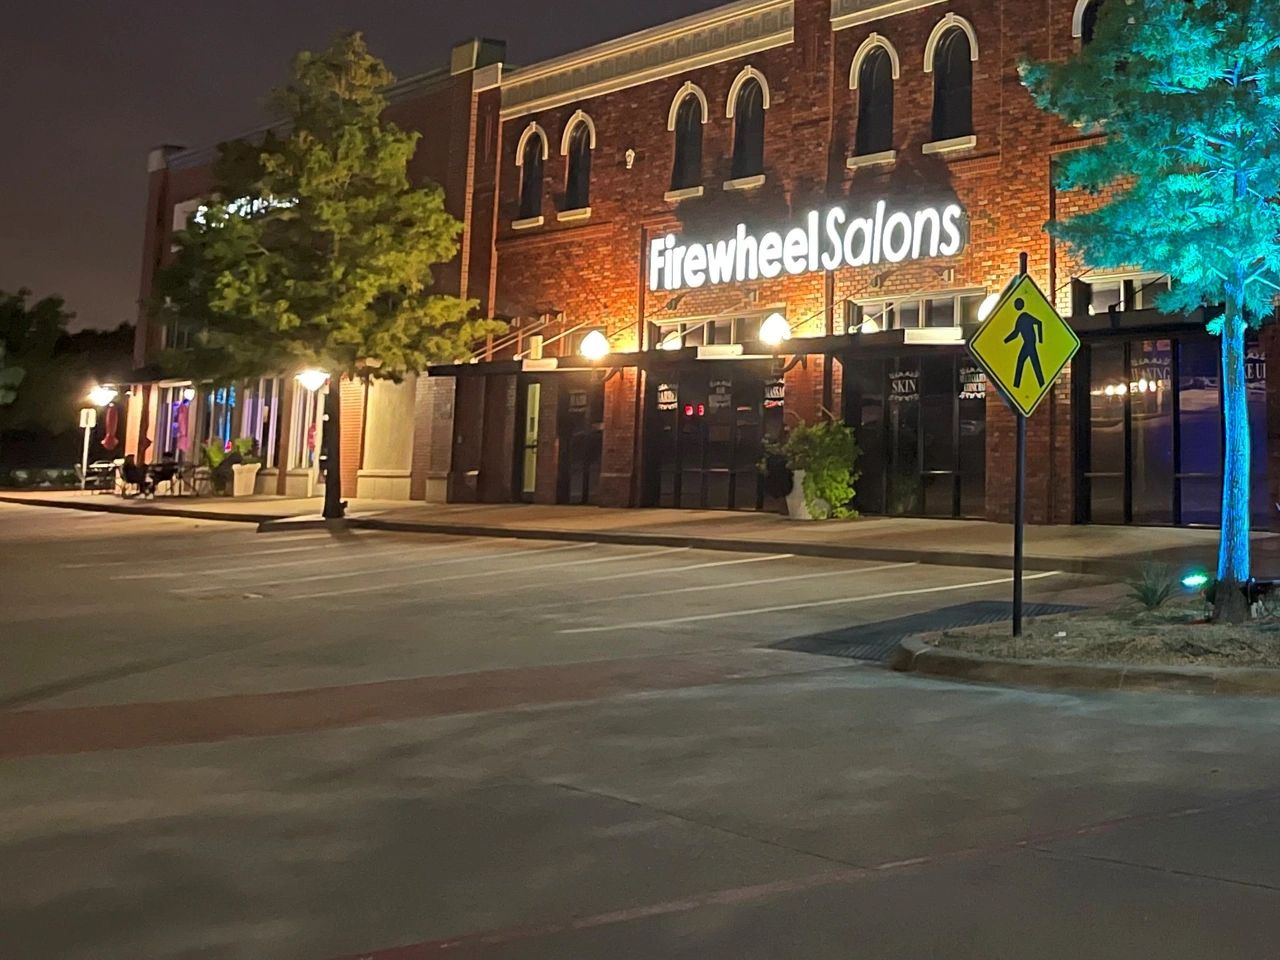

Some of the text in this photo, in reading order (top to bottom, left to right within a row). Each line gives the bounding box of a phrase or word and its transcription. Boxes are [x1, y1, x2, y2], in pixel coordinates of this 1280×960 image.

[649, 199, 962, 290] Firewheel Salons
[891, 379, 917, 393] SKIN
